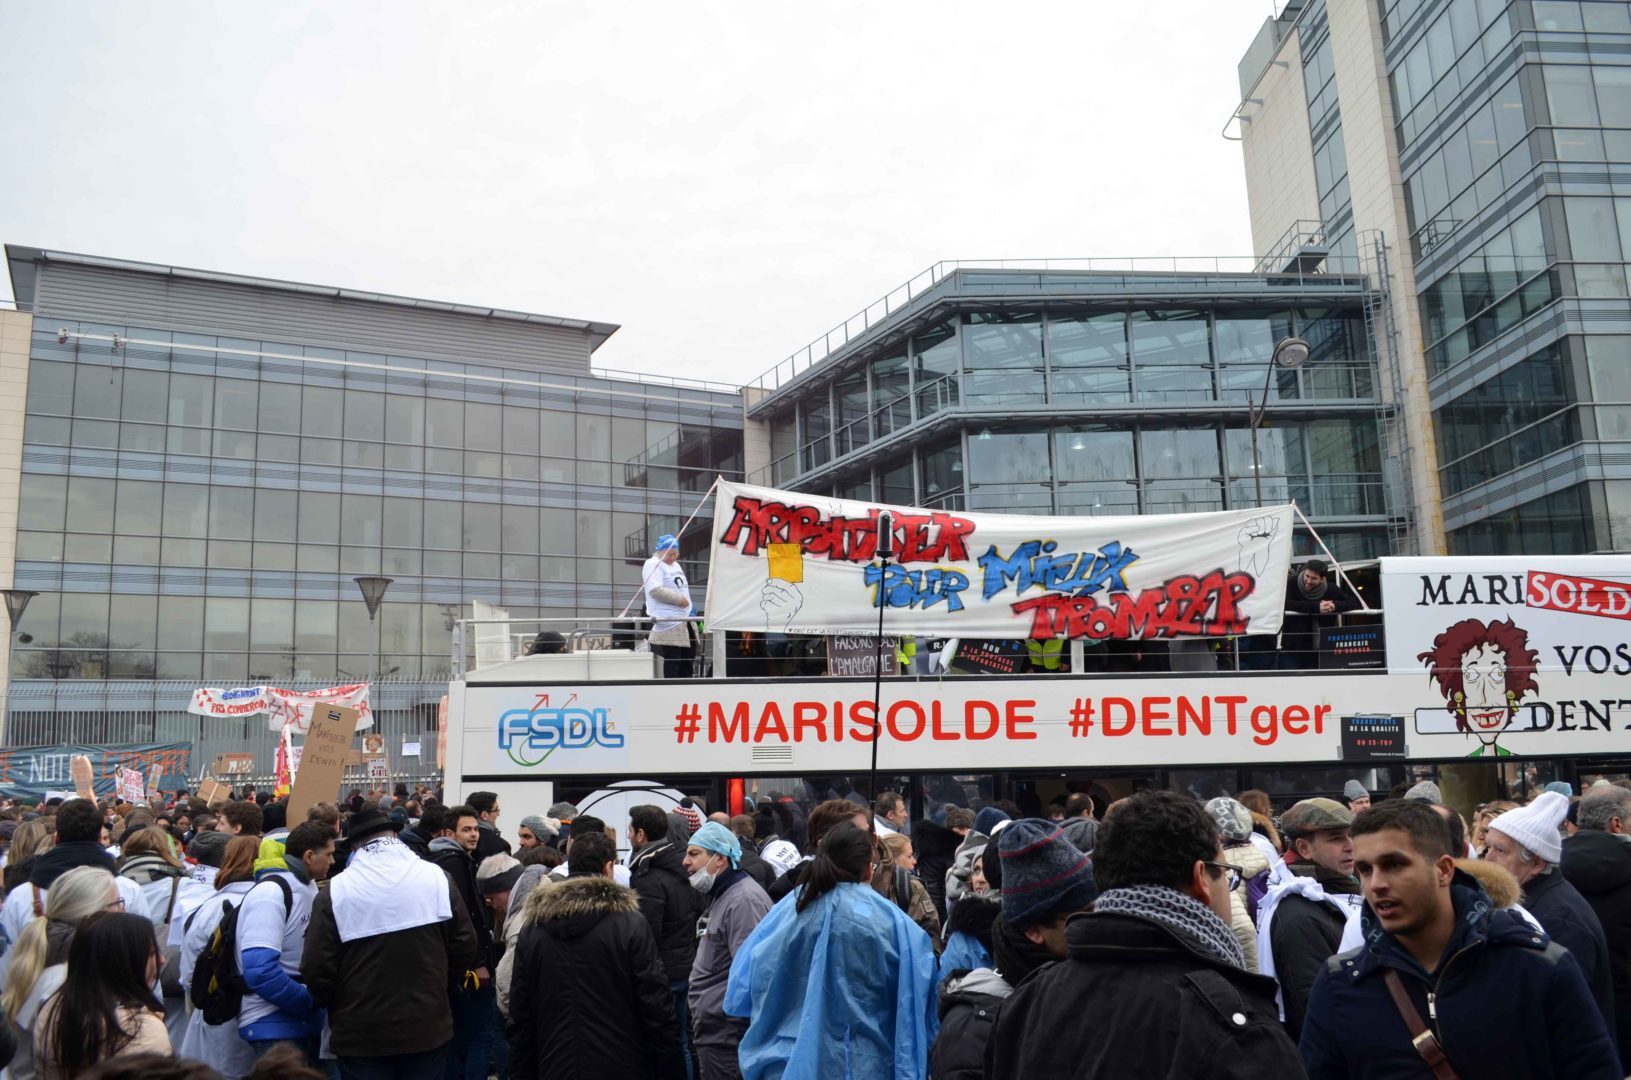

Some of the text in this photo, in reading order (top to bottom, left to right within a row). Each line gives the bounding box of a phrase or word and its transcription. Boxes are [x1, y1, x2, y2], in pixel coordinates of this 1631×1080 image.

[864, 562, 969, 613] POUR
[982, 643, 1000, 654] NON
[498, 707, 624, 750] FSDL
[674, 695, 1332, 746] #MARISOLDE #DENTger
